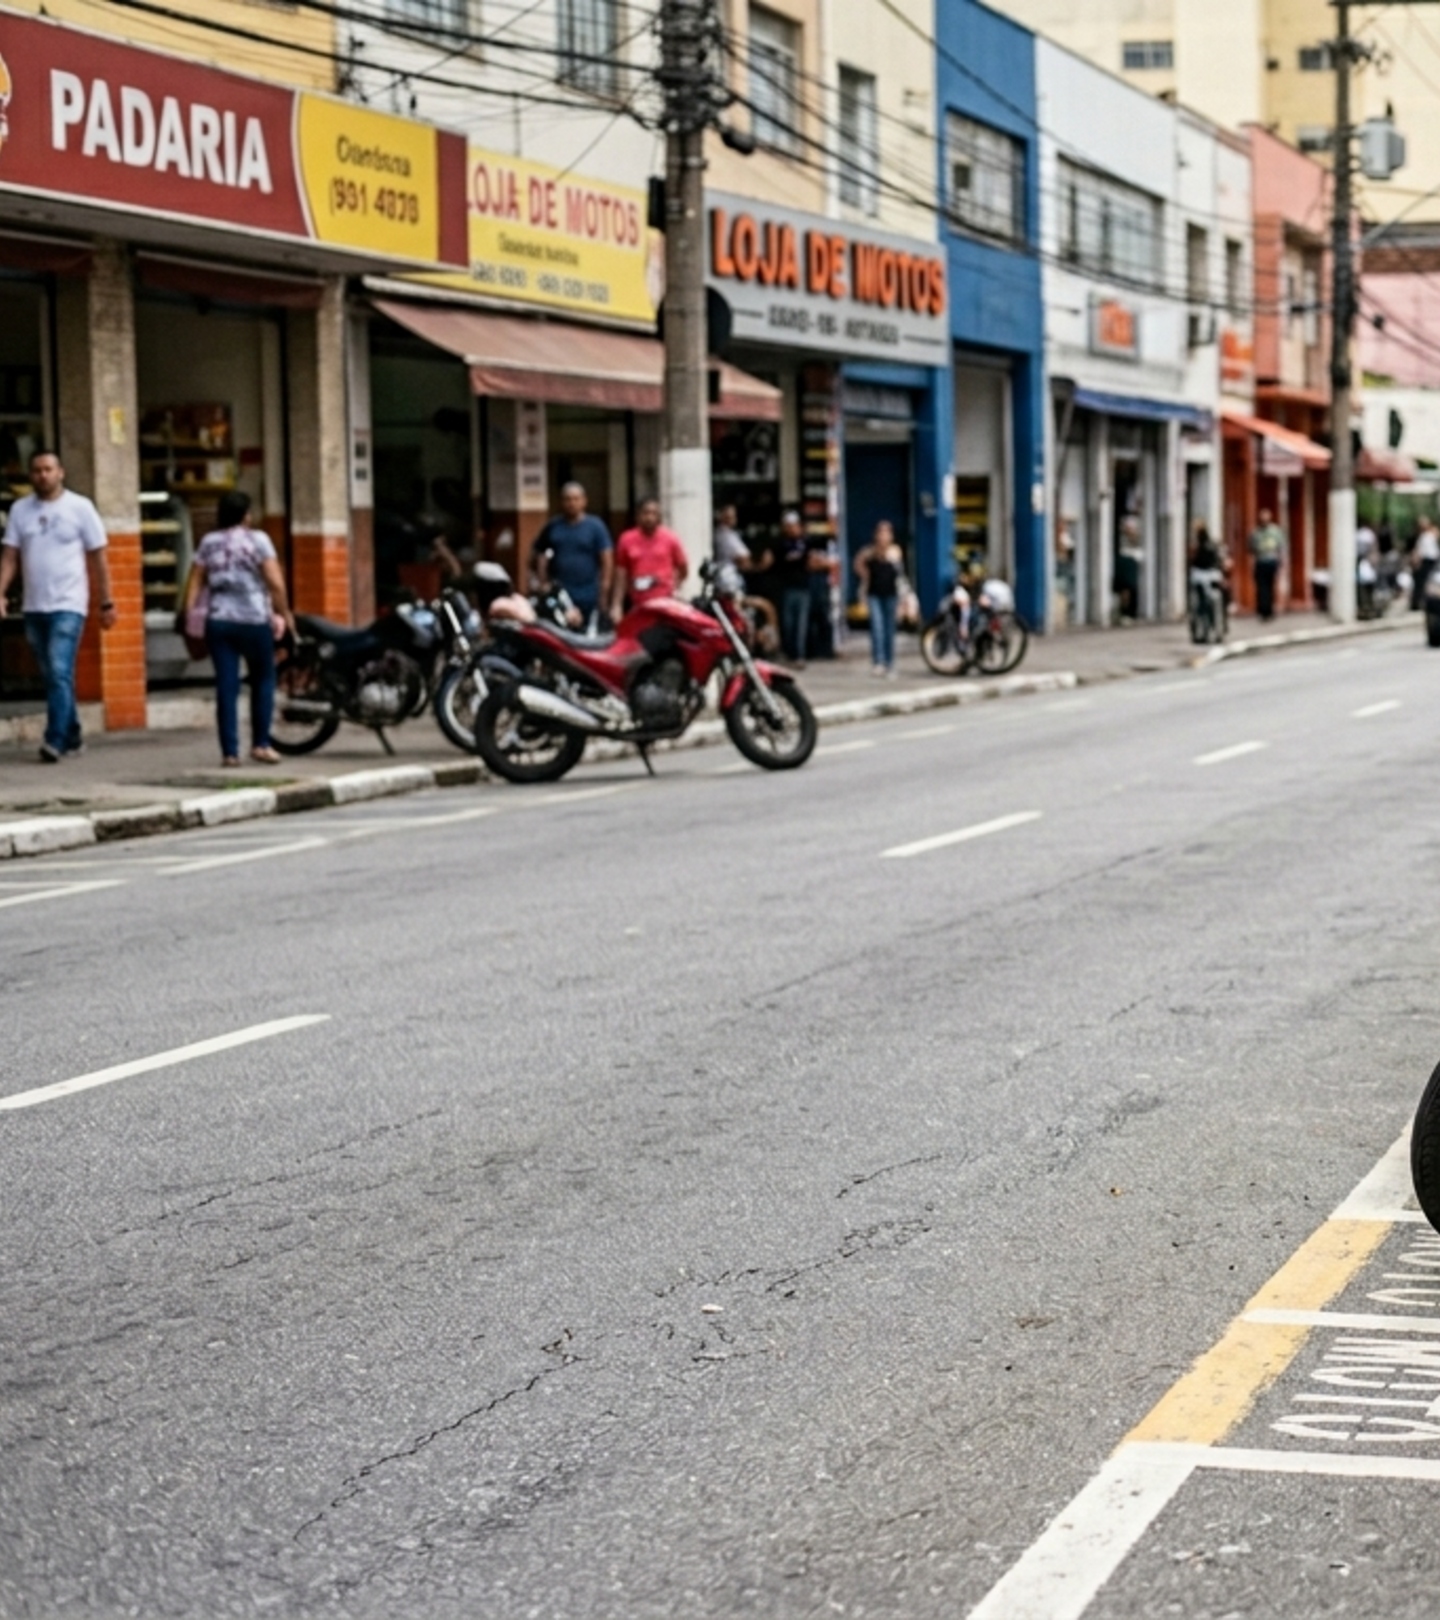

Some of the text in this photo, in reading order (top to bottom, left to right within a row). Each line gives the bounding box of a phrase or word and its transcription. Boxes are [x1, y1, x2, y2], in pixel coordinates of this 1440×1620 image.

[51, 68, 273, 195] PADARIA
[468, 162, 639, 248] OJA DE MOTOS
[711, 207, 945, 318] LOJA DE MOTOS
